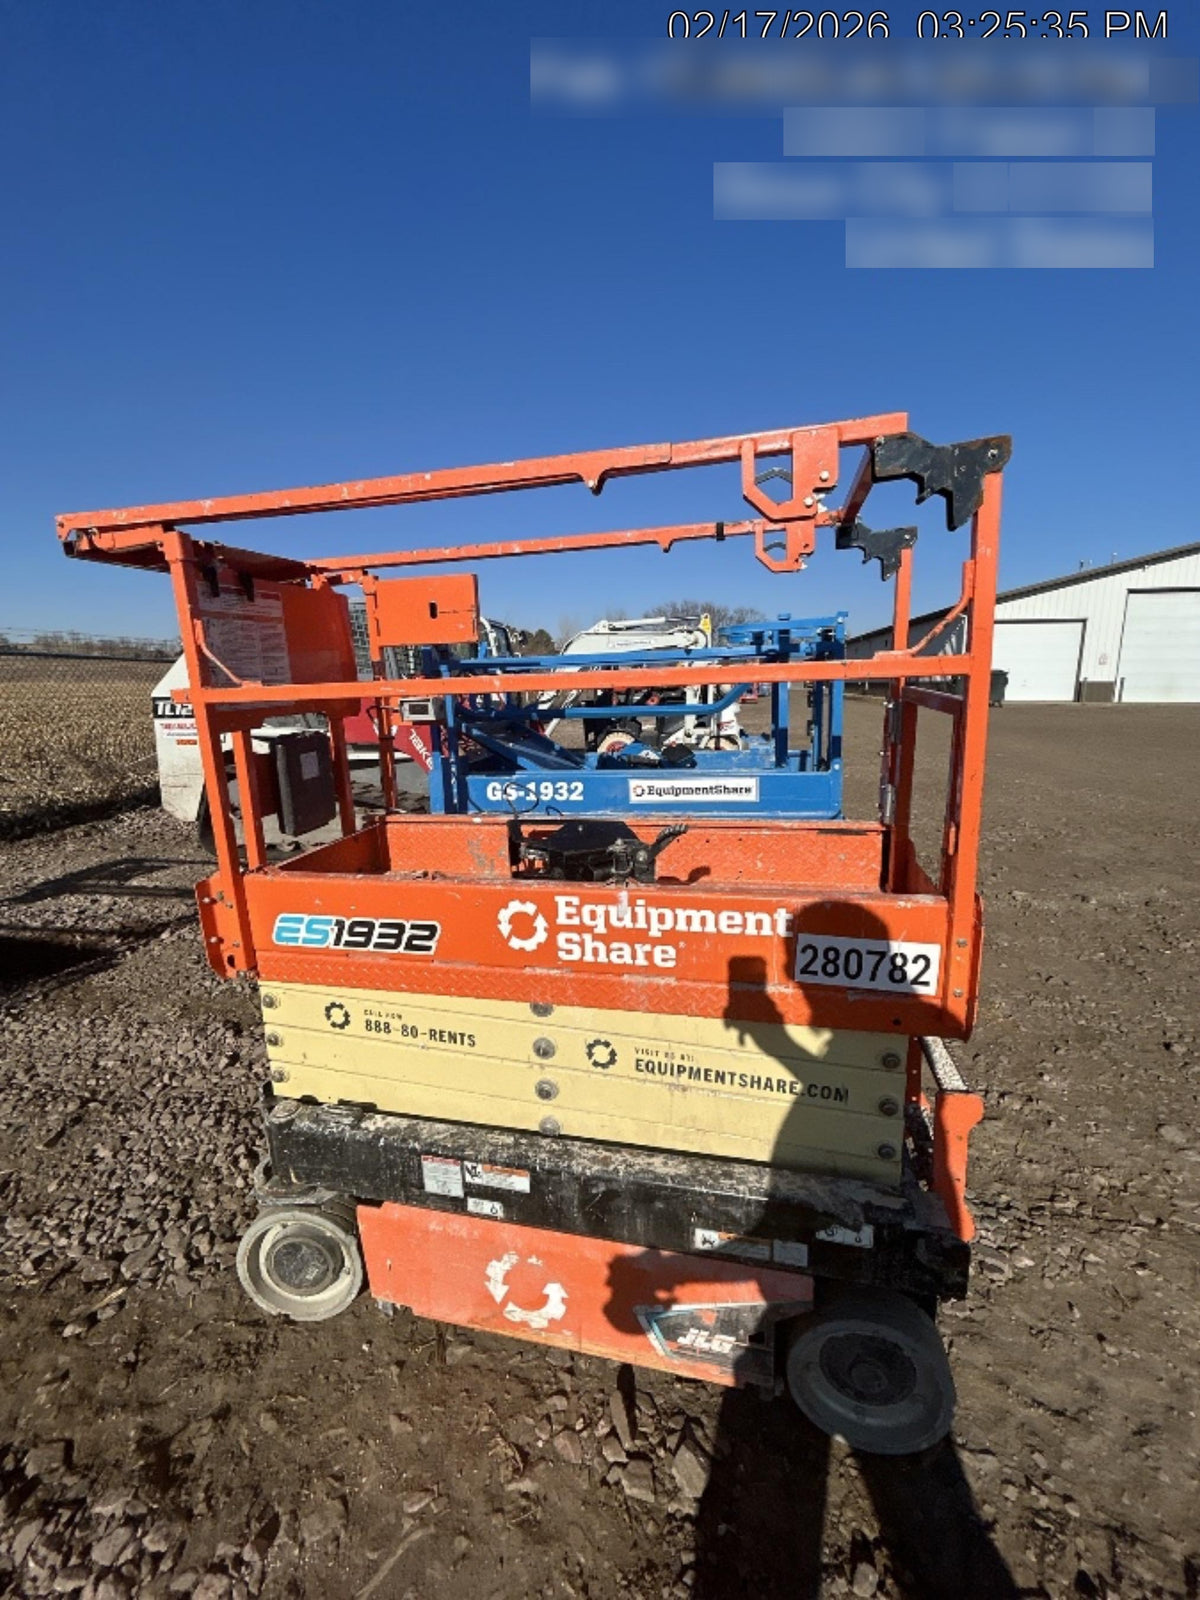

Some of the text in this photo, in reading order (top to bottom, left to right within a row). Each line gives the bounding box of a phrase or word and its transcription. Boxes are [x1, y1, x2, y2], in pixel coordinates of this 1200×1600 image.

[486, 781, 584, 801] GS-1932
[646, 785, 753, 797] EquipmentShare
[273, 914, 440, 953] ES1932
[554, 895, 793, 938] Equipment
[799, 943, 931, 986] 280782
[635, 1058, 849, 1103] EQUIPMENTSHARE.COM
